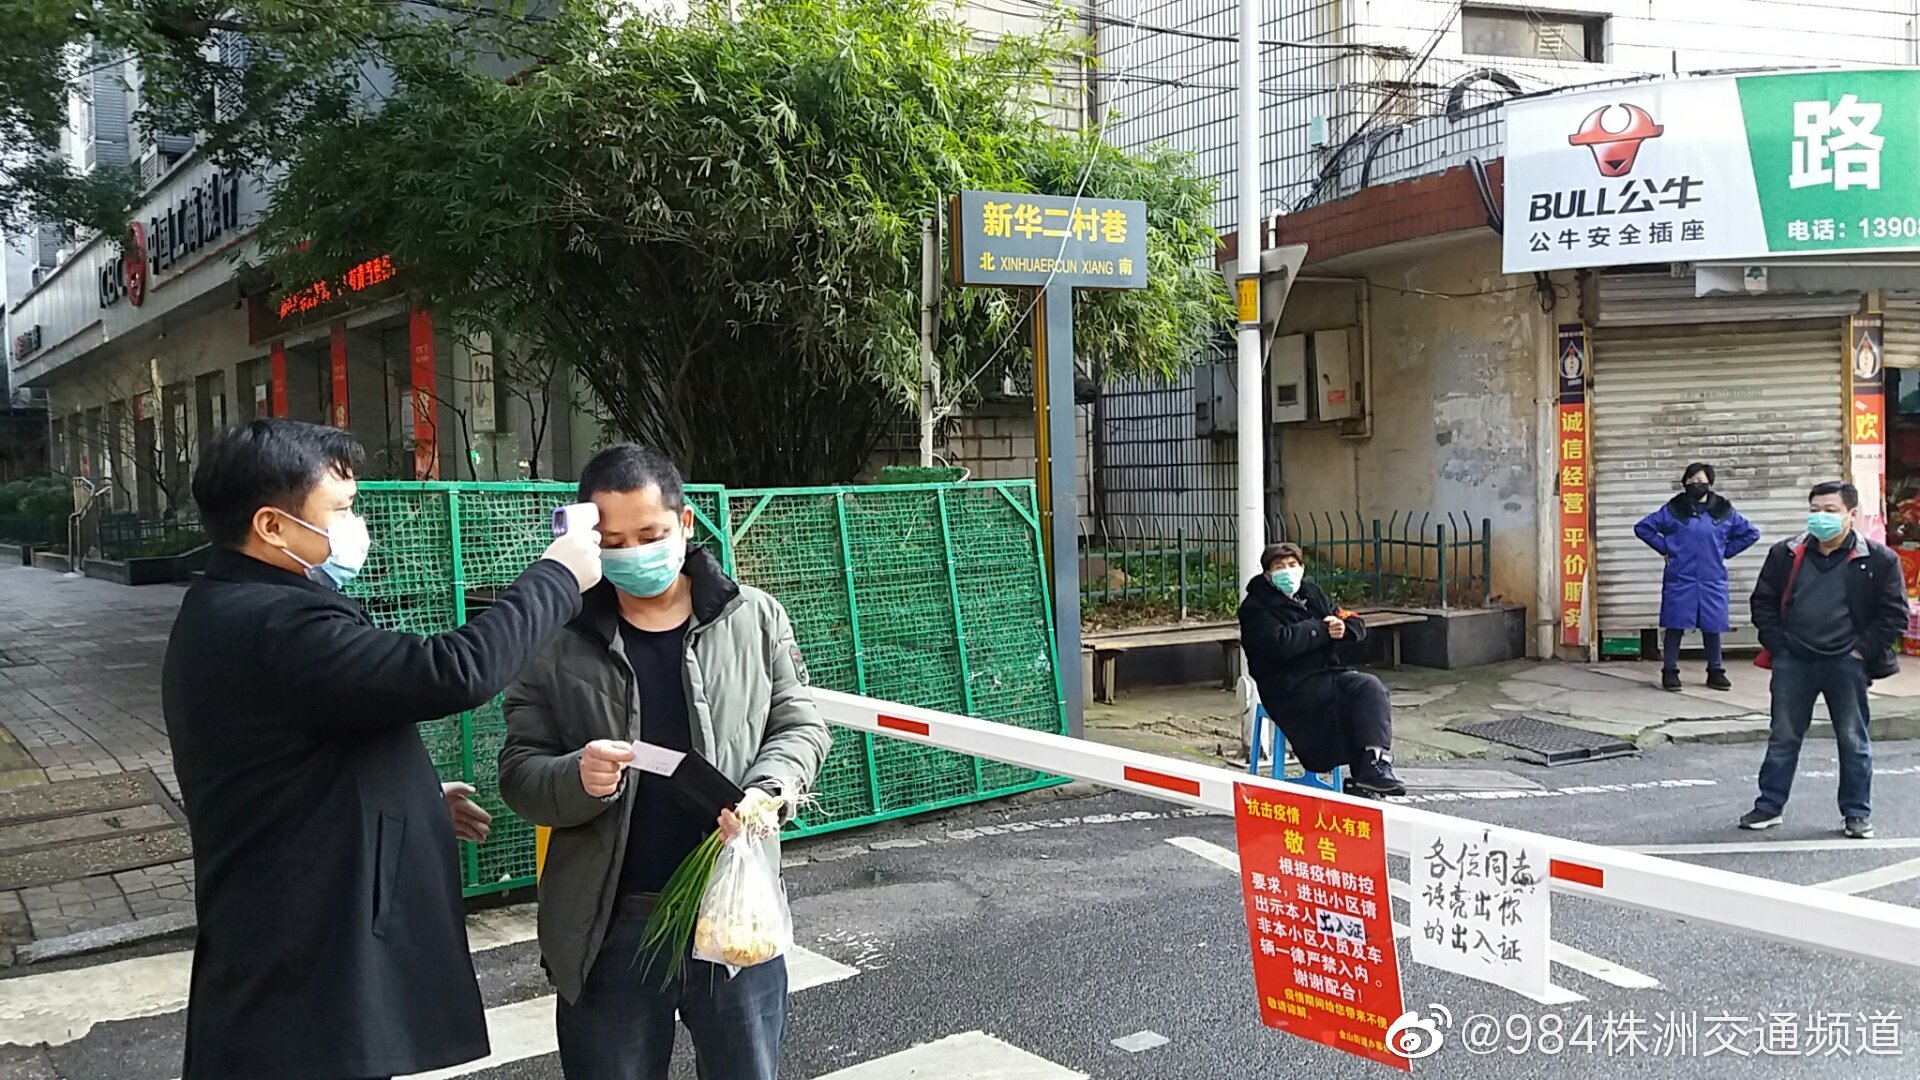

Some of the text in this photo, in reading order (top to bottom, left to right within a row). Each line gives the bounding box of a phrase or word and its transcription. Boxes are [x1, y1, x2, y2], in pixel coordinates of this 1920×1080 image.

[1788, 93, 1884, 191] 路
[982, 201, 1128, 244] 新华二村巷
[1528, 218, 1705, 253] 公牛安全插座
[979, 251, 1133, 276] 北 XINHUAERCUN XIANG 南
[1855, 412, 1879, 440] 欢
[1561, 411, 1585, 515] 诚信经营
[1563, 527, 1586, 629] 平价服务
[1247, 798, 1372, 840] 抗击疫情 人人有责
[1251, 871, 1377, 920] 要求，进出小区请
[1278, 856, 1375, 896] 根据疫情防控
[1422, 881, 1522, 926] 请亮出你
[1257, 916, 1383, 965] 非本小区人员及车
[1423, 917, 1522, 962] 的出入证
[1284, 988, 1389, 1030] 疫情期间给您带来不便
